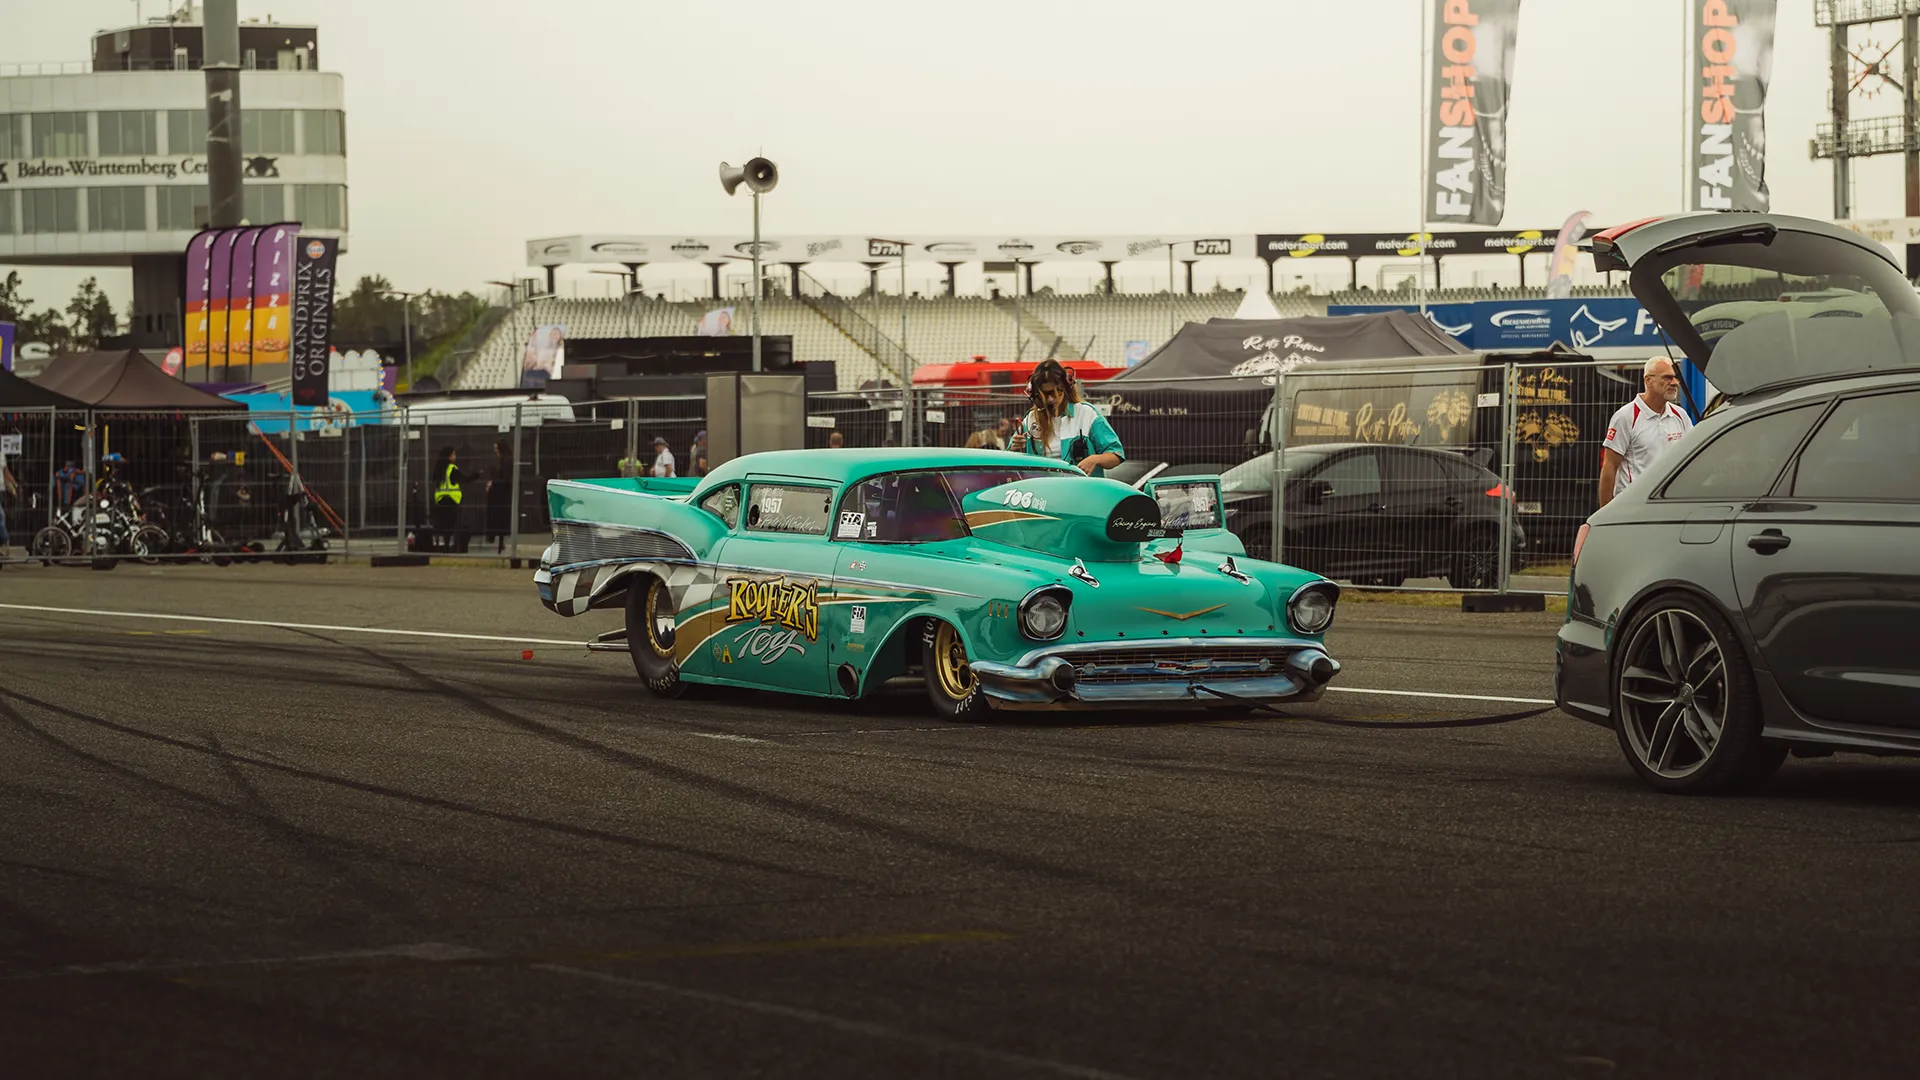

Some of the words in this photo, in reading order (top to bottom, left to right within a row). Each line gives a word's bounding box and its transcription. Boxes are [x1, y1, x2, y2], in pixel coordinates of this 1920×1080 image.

[1436, 0, 1479, 216] FANSHOP
[1699, 0, 1740, 210] FANSHOP
[17, 157, 177, 179] Baden-Württemberg
[1268, 240, 1349, 251] motorsport.com
[267, 228, 285, 330] PIZZA
[293, 261, 313, 381] GRANDPRIX
[308, 267, 332, 376] ORIGINALS
[761, 497, 783, 514] 1957
[1003, 489, 1034, 510] 706
[725, 577, 819, 642] ROOFERS
[733, 625, 806, 665] Toy
